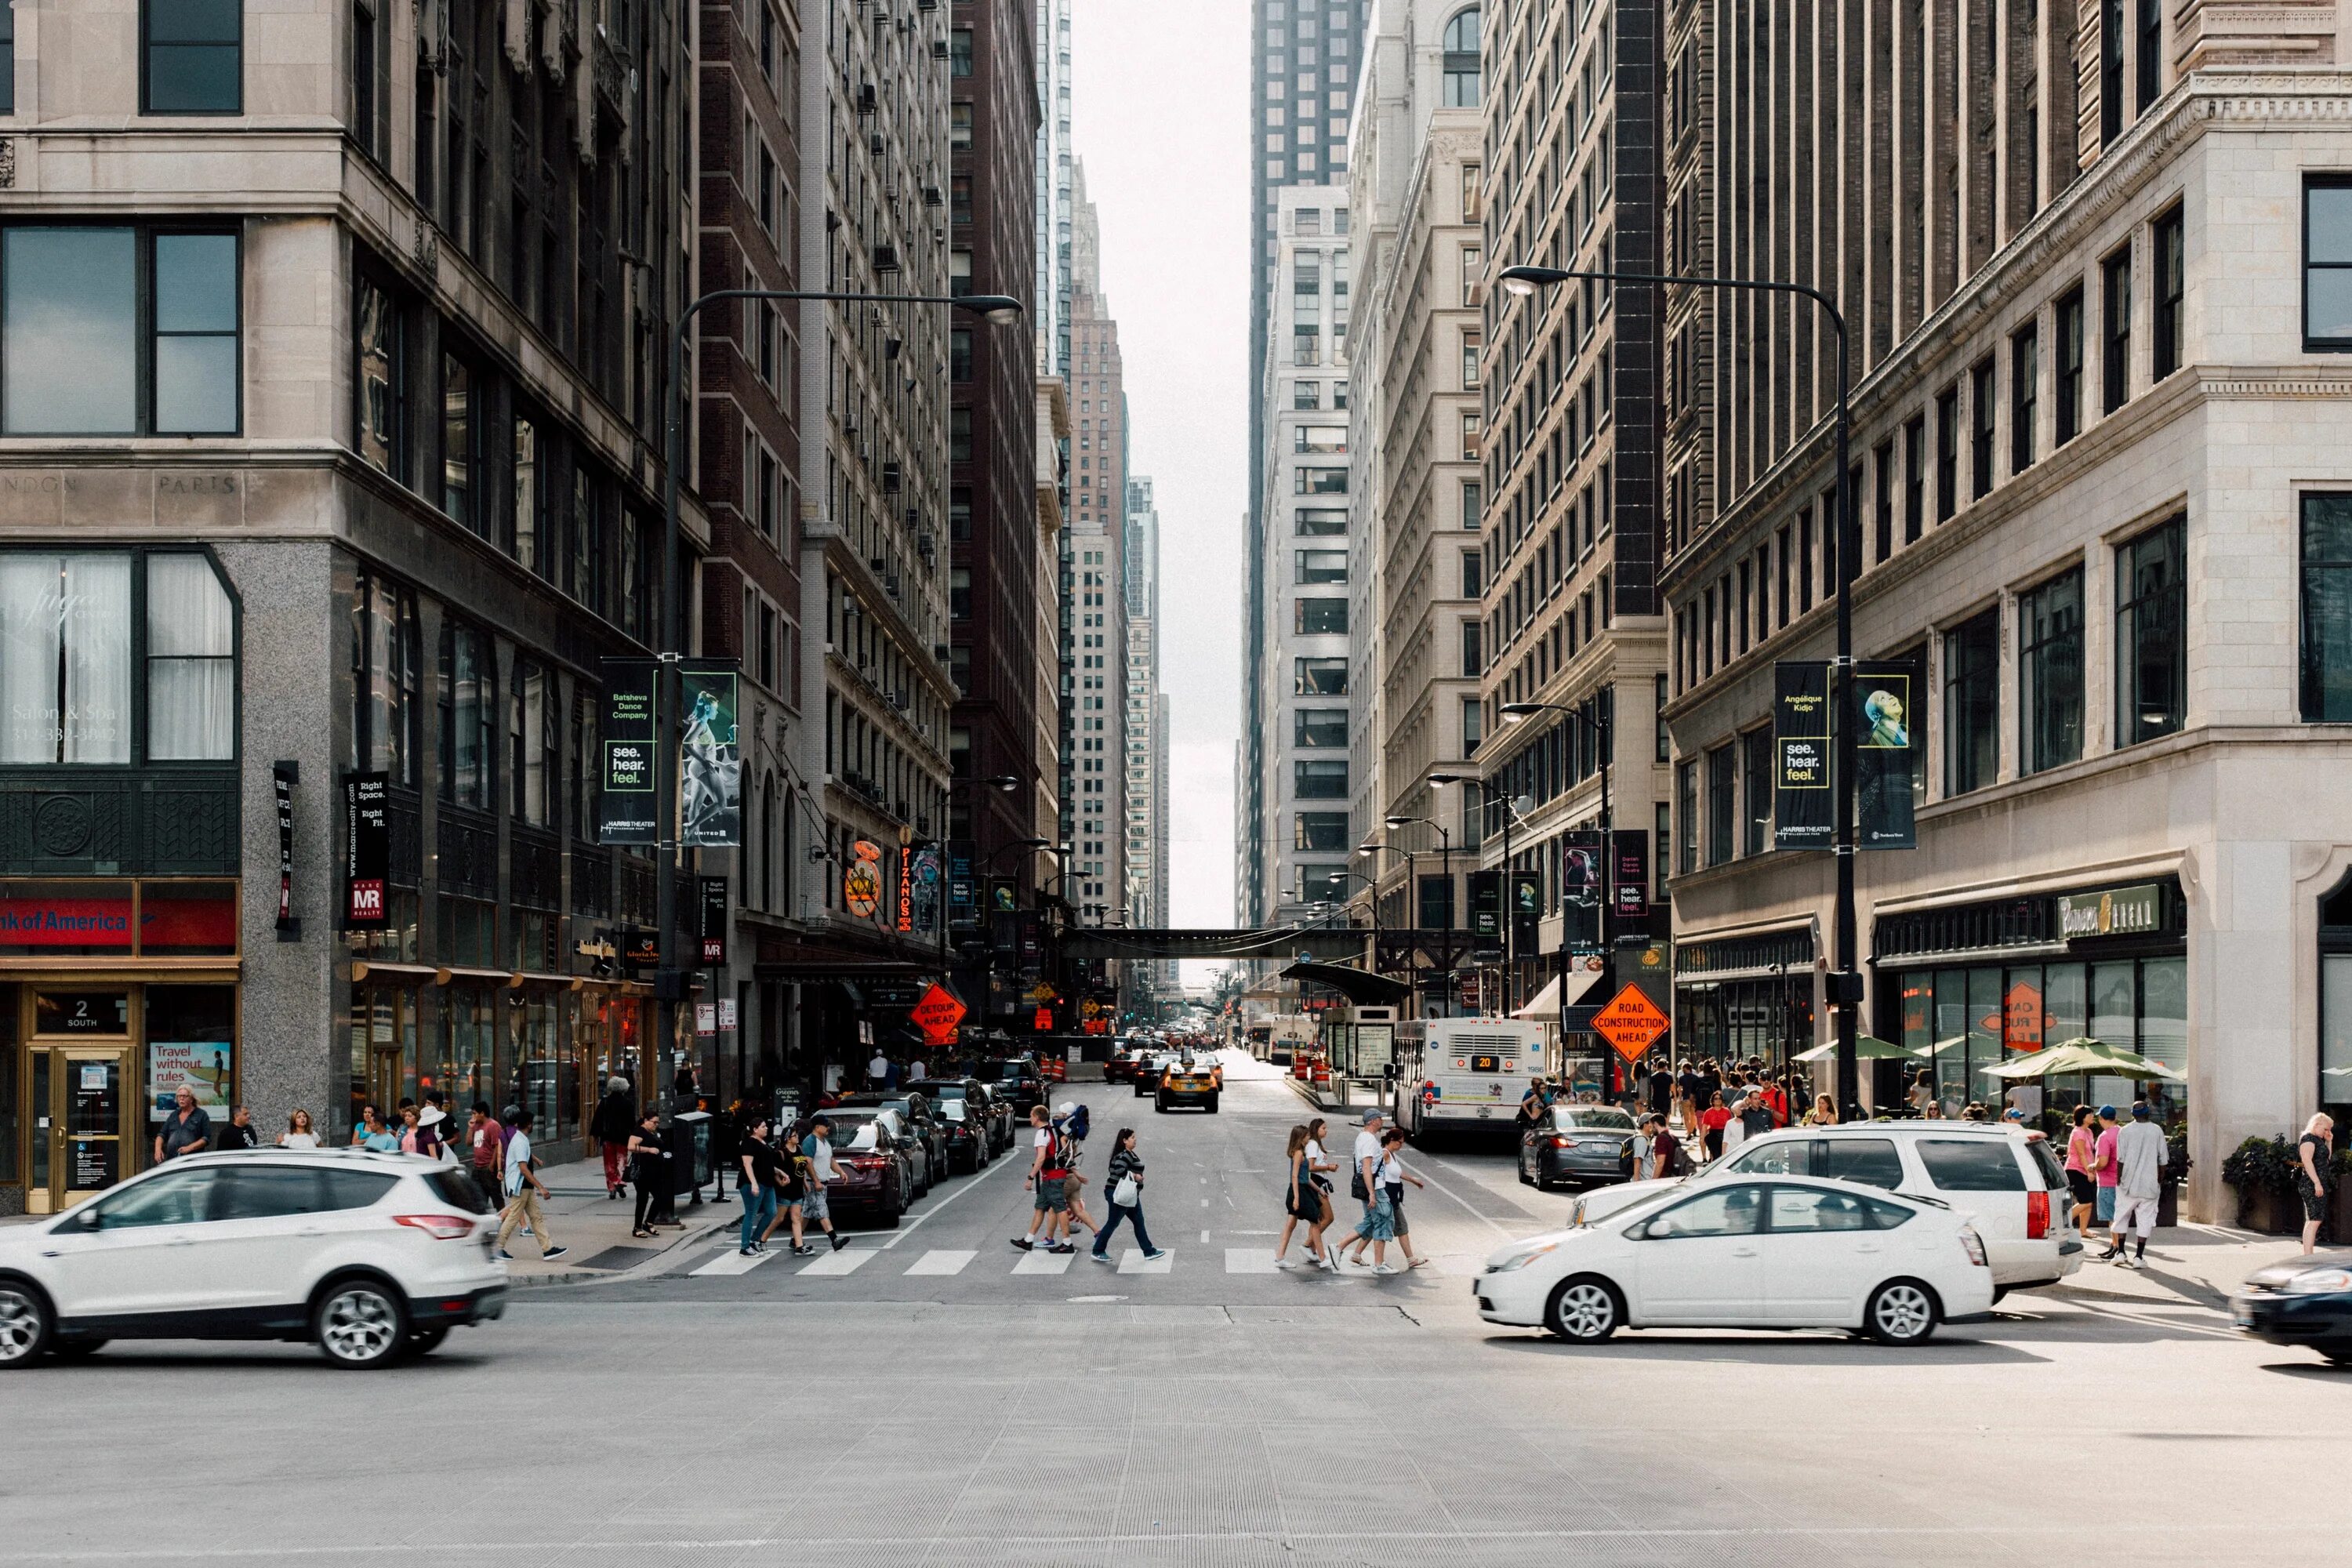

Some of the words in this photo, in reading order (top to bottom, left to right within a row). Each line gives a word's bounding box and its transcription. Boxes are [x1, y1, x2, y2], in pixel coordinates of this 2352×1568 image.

[159, 476, 235, 495] PARIS
[1785, 695, 1823, 704] Angélique
[13, 704, 59, 720] Salon
[66, 705, 78, 720] &
[86, 704, 115, 724] Spa
[1794, 704, 1813, 713] Kidjo
[612, 711, 648, 720] Company
[613, 747, 641, 758] see.
[1787, 744, 1815, 754] see.
[612, 757, 645, 771] hear.
[1787, 755, 1820, 768] hear.
[612, 771, 641, 783] feel.
[1787, 768, 1816, 781] feel.
[358, 791, 386, 800] Space.
[361, 810, 383, 818] Right
[901, 848, 910, 916] PIZANOS
[354, 890, 380, 908] MR
[23, 910, 42, 931] of
[45, 911, 126, 931] America
[705, 945, 720, 956] MR
[76, 1000, 87, 1017] 2
[920, 1003, 956, 1014] DETOUR
[1619, 1004, 1644, 1013] ROAD
[924, 1014, 956, 1025] AHEAD
[1598, 1018, 1664, 1028] CONSTRUCTION
[1616, 1033, 1647, 1042] AHEAD
[155, 1045, 191, 1056] Travel
[156, 1058, 203, 1069] without
[1479, 1058, 1490, 1067] 20
[156, 1070, 185, 1081] rules
